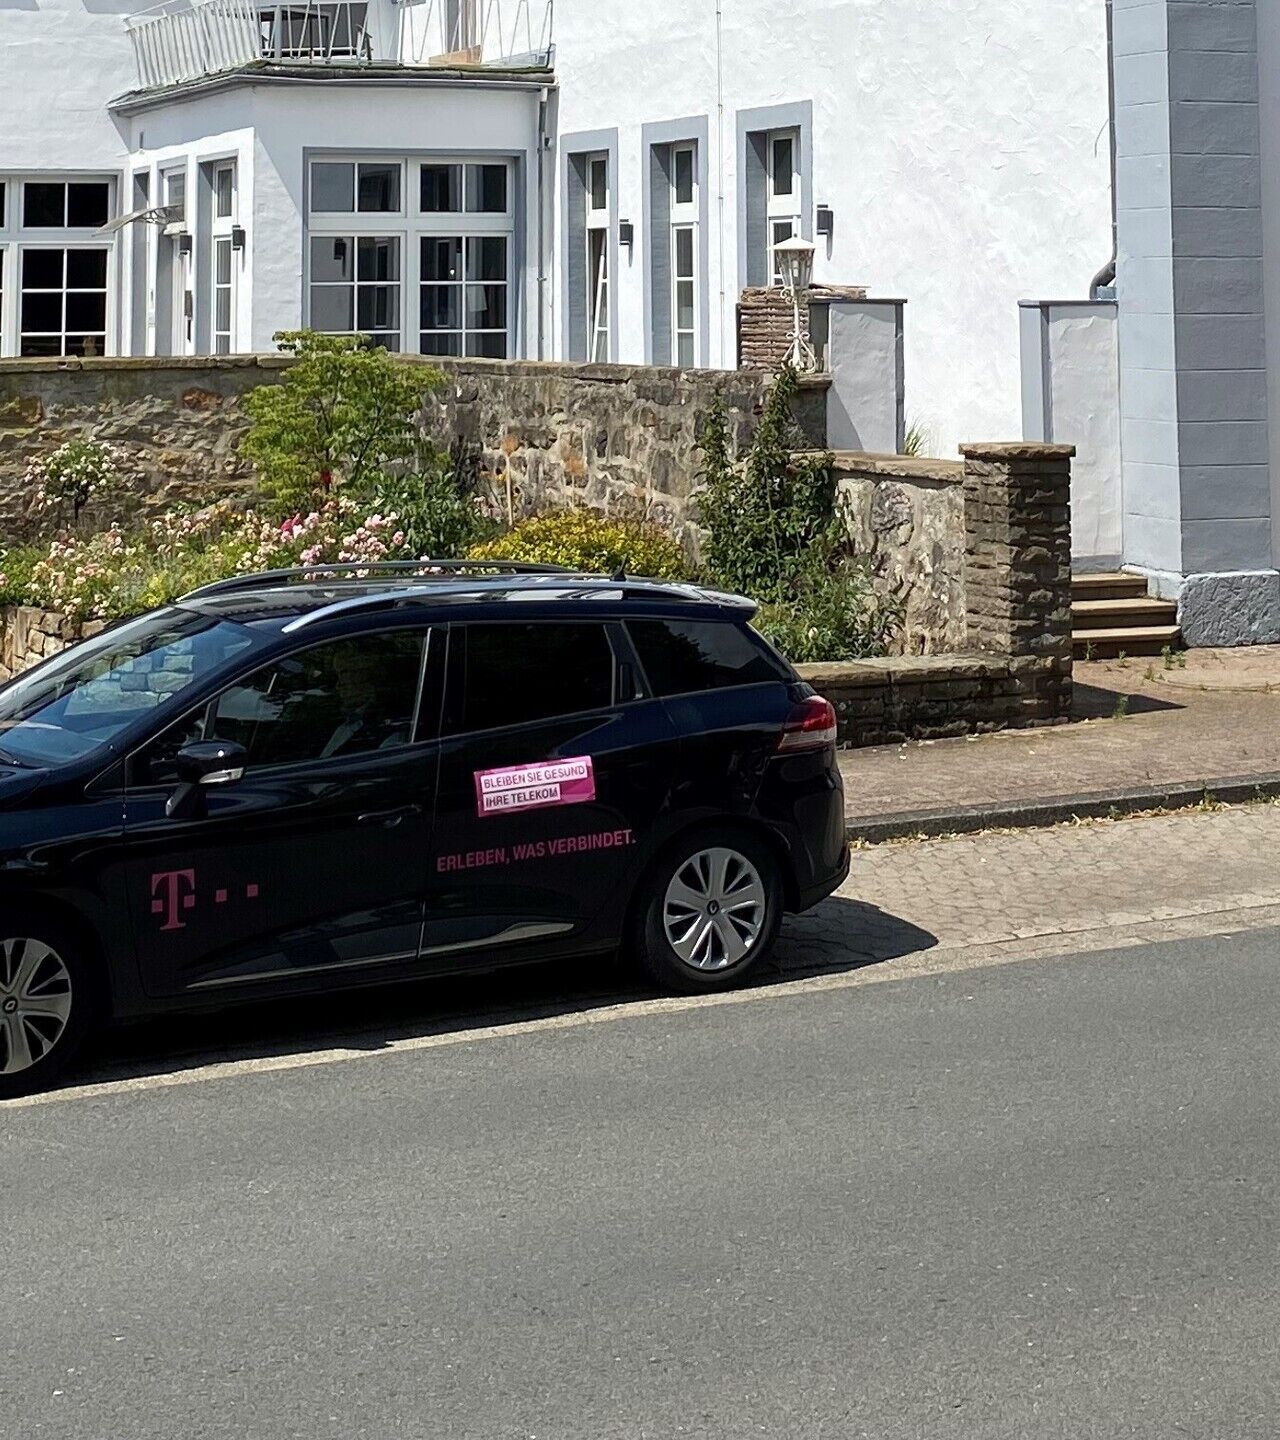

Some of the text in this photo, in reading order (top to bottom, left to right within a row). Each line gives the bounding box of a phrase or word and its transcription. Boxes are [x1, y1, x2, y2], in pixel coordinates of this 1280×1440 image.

[483, 764, 585, 789] BLEIBEN SIE GESUND
[485, 787, 558, 807] IHRE TELEKOM
[436, 829, 636, 873] ERLEBEN, WAS VERBINDET.
